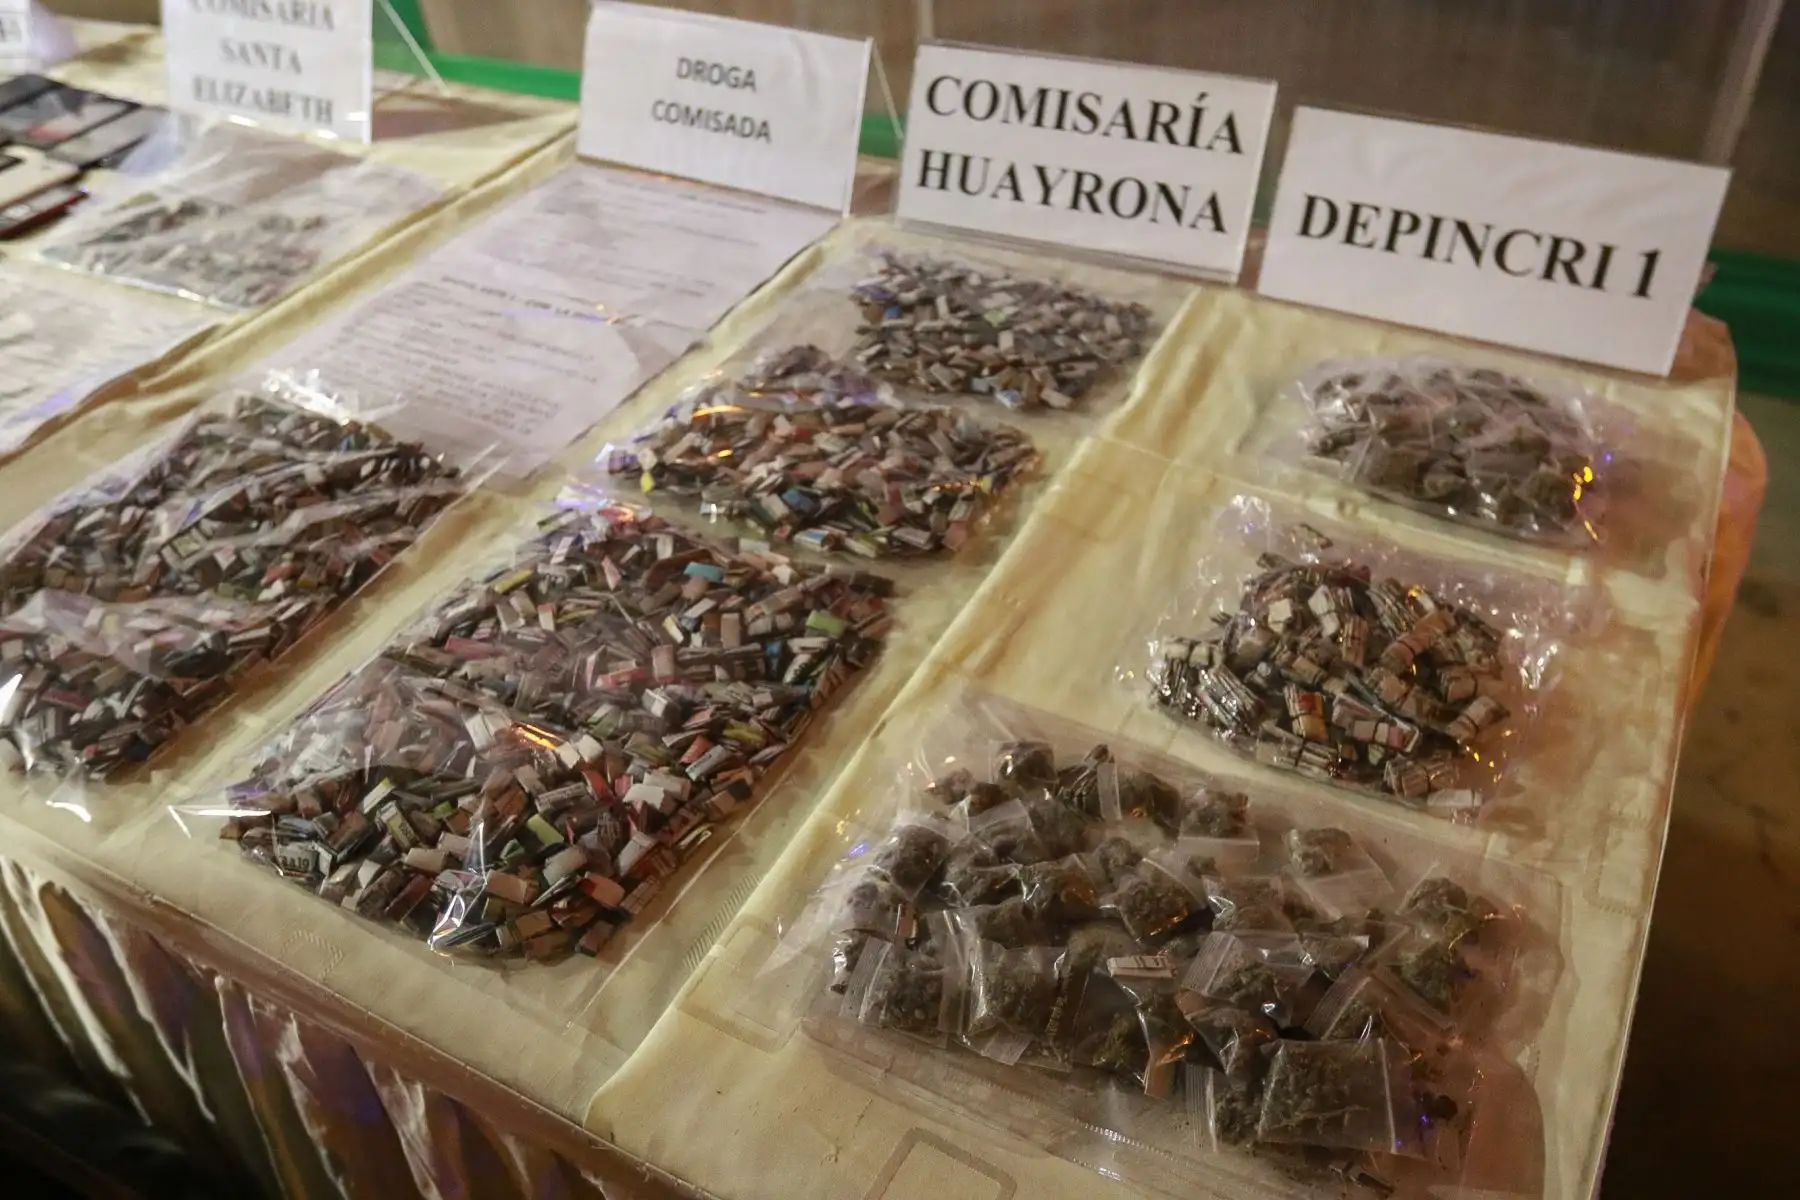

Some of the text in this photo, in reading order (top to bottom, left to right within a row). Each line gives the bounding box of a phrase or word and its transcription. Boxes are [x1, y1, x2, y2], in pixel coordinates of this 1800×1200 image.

[219, 38, 302, 75] SANTA
[676, 57, 757, 92] DROGA
[192, 74, 333, 125] ELIZABETH
[651, 99, 771, 144] COMISADA
[925, 75, 1245, 155] COMISARÍA
[915, 148, 1227, 233] HUAYRONA
[1297, 193, 1662, 300] DEPINCRI 1
